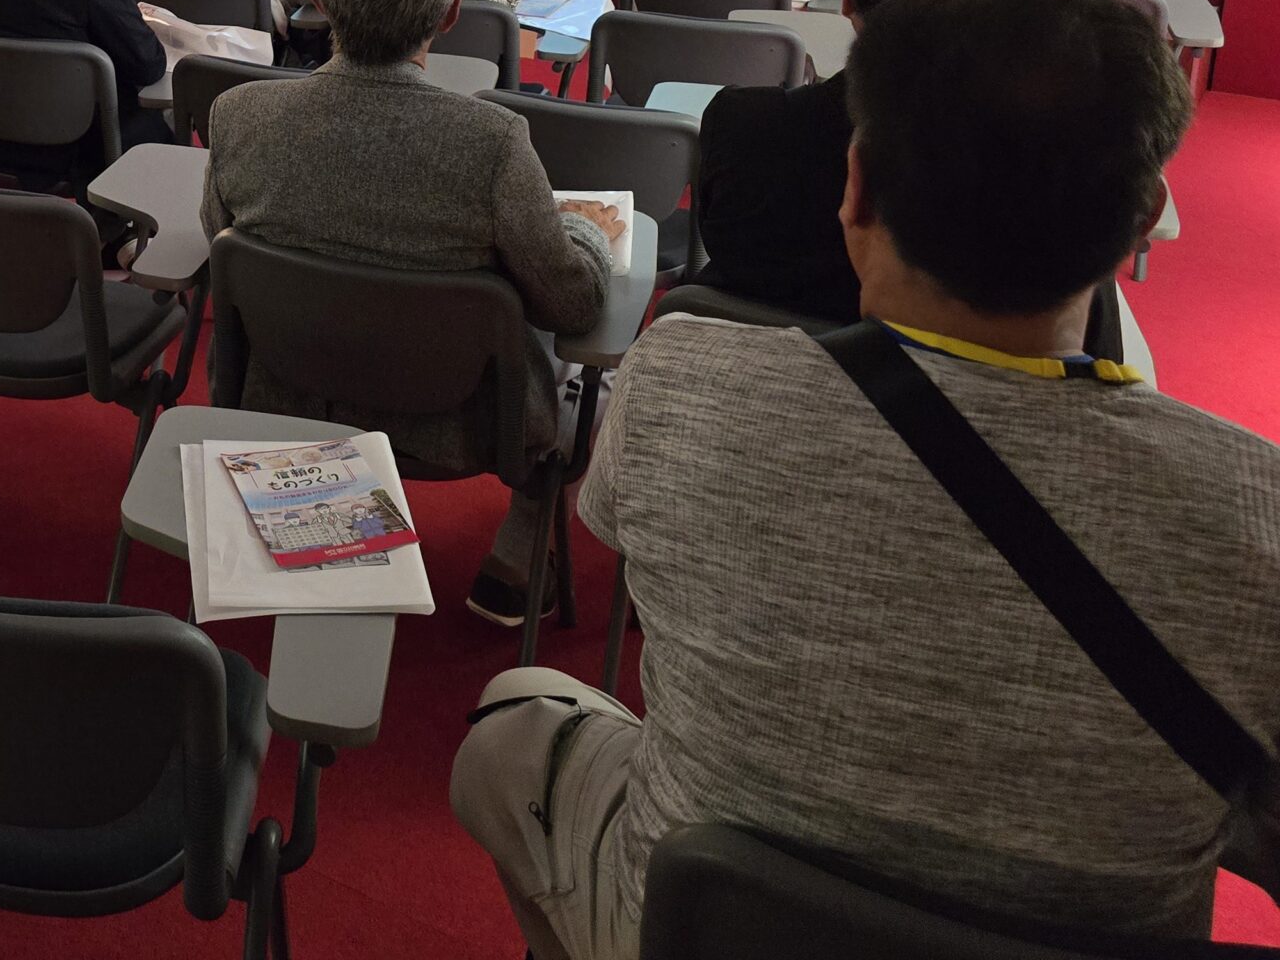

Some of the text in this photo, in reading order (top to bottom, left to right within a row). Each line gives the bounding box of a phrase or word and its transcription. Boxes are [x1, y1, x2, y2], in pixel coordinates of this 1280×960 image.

[273, 466, 322, 480] 信頼の
[268, 473, 339, 490] ものづくり
